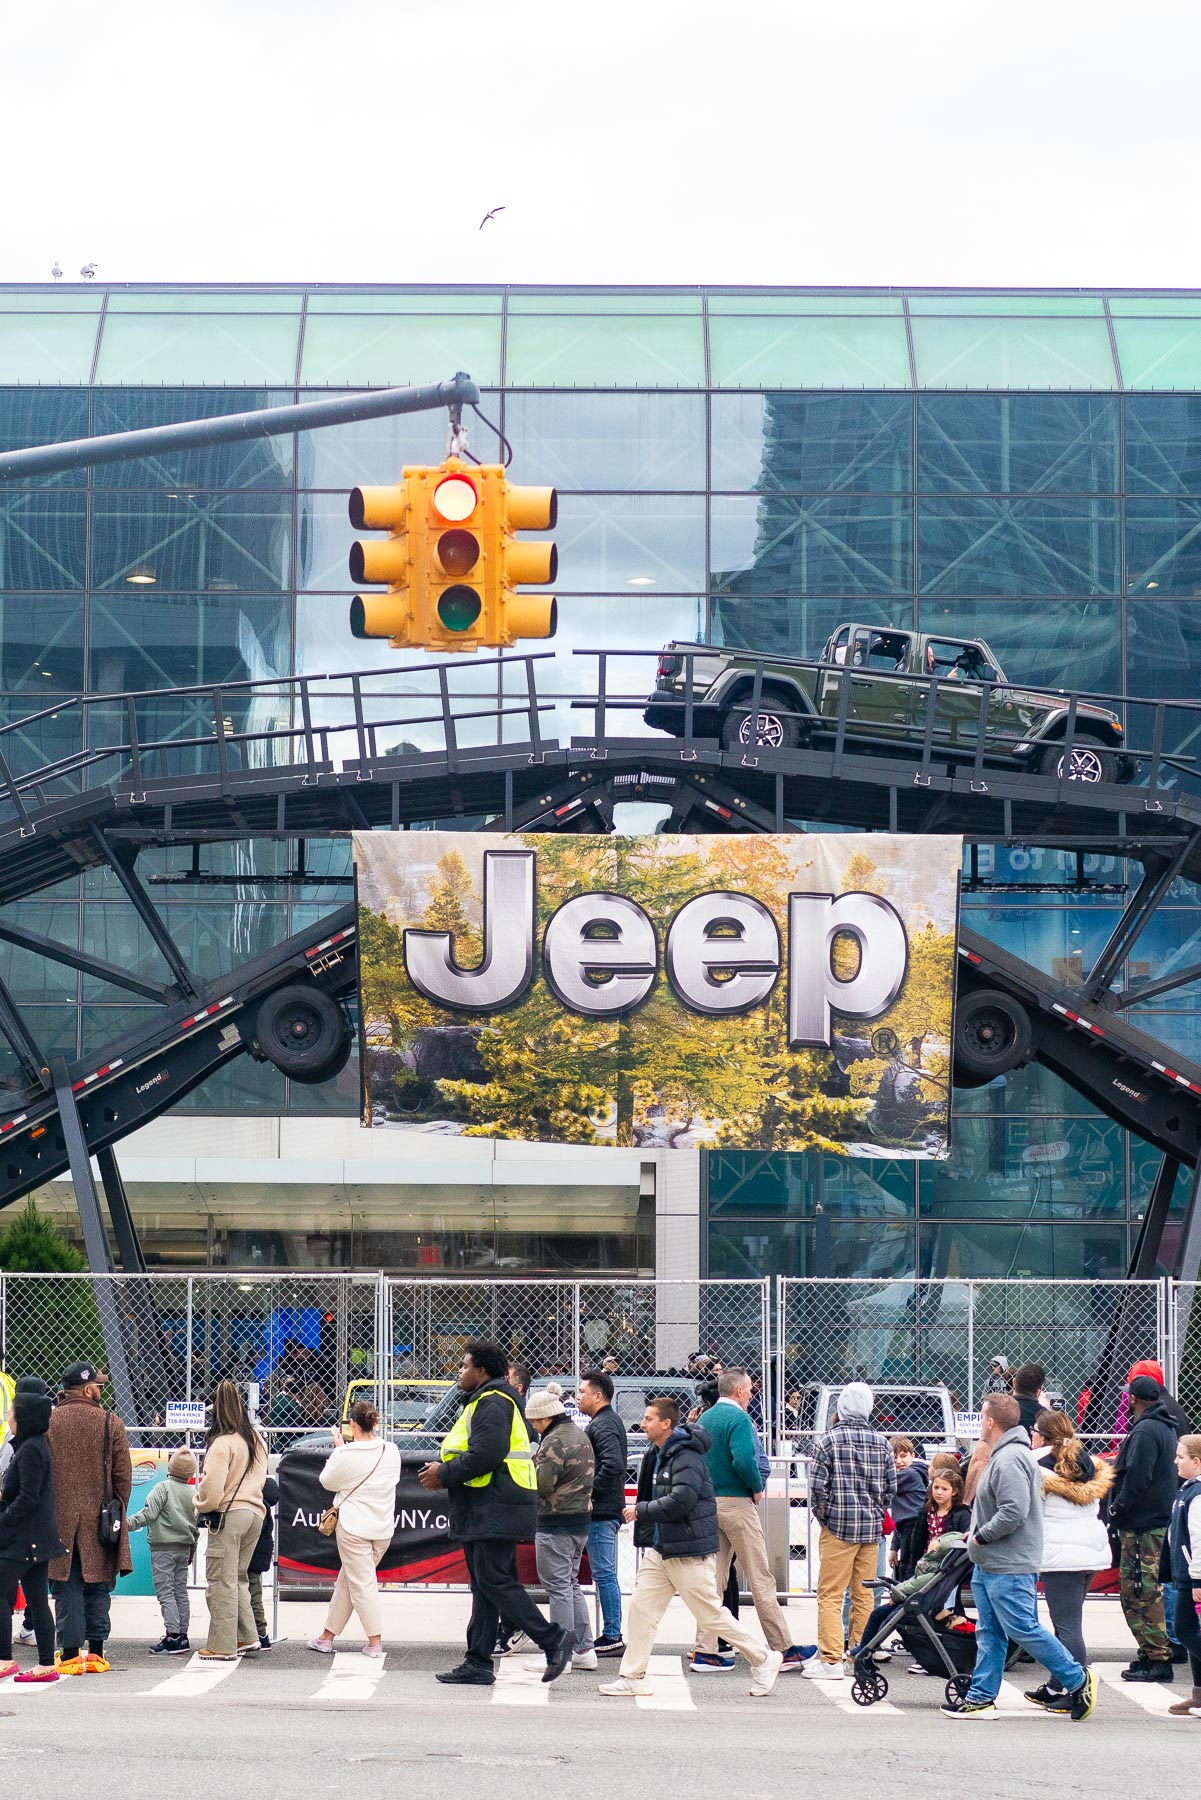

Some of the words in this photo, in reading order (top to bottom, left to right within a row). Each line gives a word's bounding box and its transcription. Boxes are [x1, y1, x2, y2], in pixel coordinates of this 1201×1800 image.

[404, 850, 908, 1049] Jeep
[135, 1073, 162, 1094] Legend
[1112, 1078, 1140, 1098] Legend
[168, 1403, 204, 1411] EMPIRE
[957, 1413, 983, 1421] EMPI
